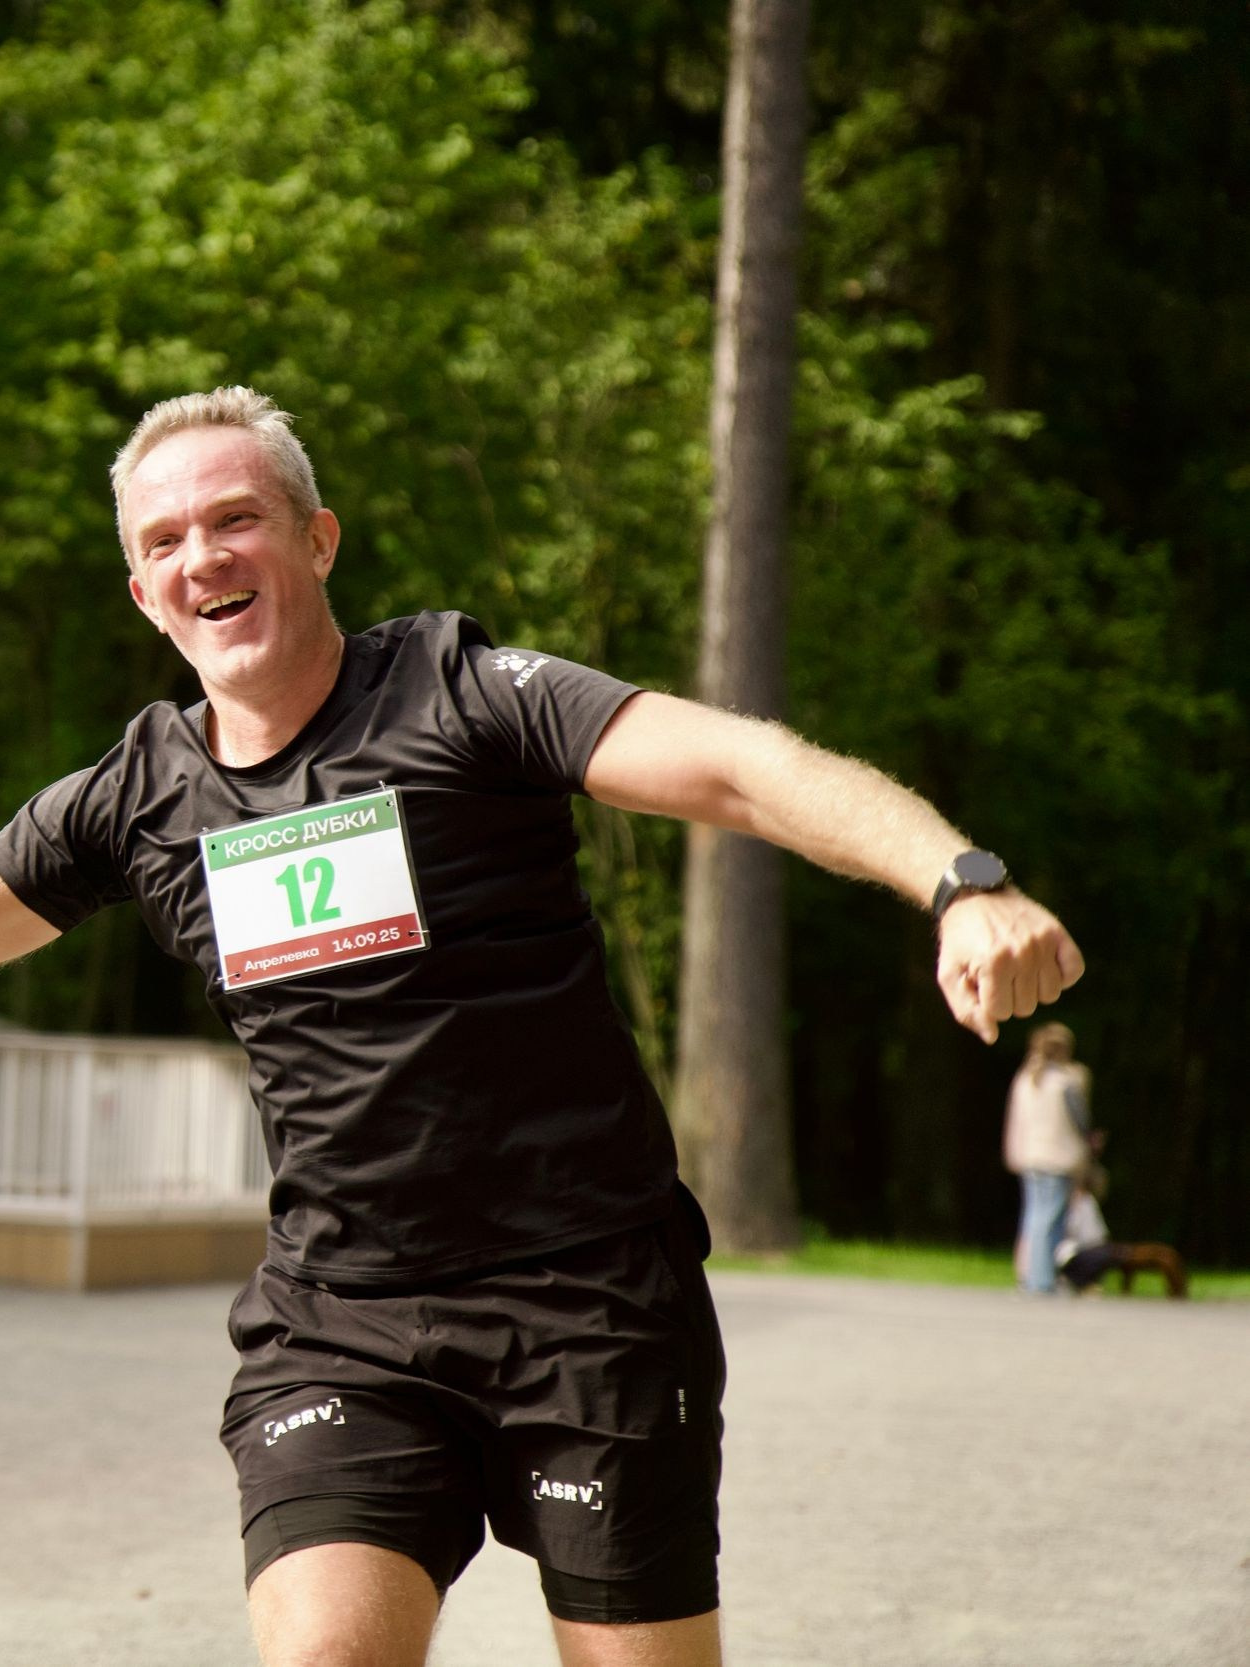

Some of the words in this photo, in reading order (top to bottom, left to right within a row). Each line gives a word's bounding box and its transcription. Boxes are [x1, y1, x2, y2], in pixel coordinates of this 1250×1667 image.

[224, 826, 297, 859] КРОСС
[302, 807, 378, 843] ДУБКИ
[274, 856, 342, 928] 12
[244, 946, 320, 973] Апрелевка
[332, 927, 401, 953] 14.09.25
[273, 1404, 333, 1438] ASRV
[539, 1479, 594, 1504] ASRV
